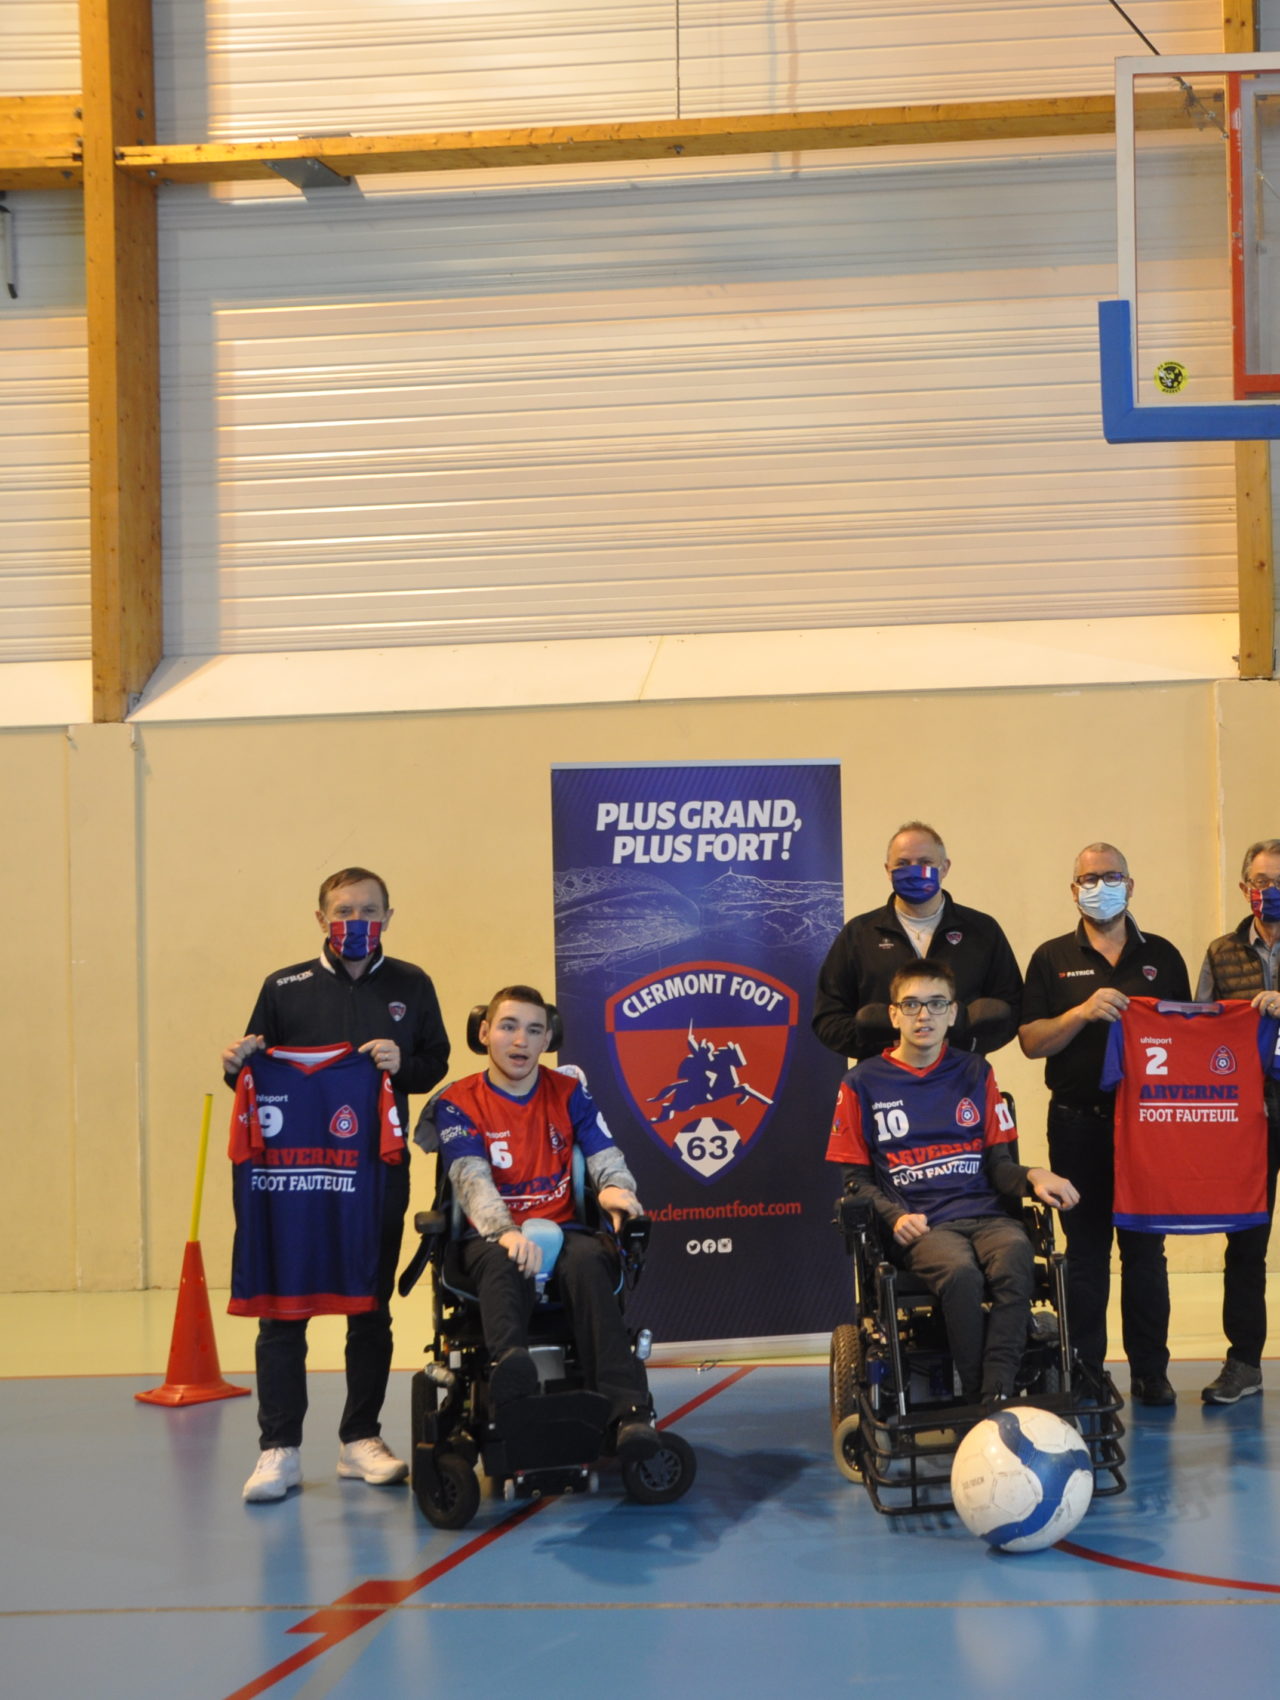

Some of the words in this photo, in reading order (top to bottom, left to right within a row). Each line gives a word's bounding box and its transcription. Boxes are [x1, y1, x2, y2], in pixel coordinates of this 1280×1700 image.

[596, 802, 676, 831] PLUS
[679, 799, 802, 832] GRAND,
[612, 834, 692, 864] PLUS
[696, 833, 779, 862] FORT
[622, 973, 726, 1018] CLERMONT
[729, 976, 784, 1012] FOOT
[1140, 1036, 1172, 1045] uhlsport
[1145, 1047, 1168, 1075] 2
[256, 1094, 288, 1103] hlsport
[1139, 1084, 1239, 1099] ARVERNE
[872, 1100, 903, 1111] uhlsport
[1139, 1109, 1174, 1122] FOOT
[1176, 1109, 1239, 1122] FAUTEUIL
[257, 1105, 283, 1137] 9
[874, 1110, 909, 1141] 10
[490, 1141, 513, 1169] 6
[686, 1135, 729, 1161] 63
[887, 1138, 982, 1168] ARVERNE
[252, 1175, 287, 1191] FOOT
[289, 1175, 356, 1192] FAUTEUIL
[893, 1170, 923, 1186] FOOT
[643, 1201, 802, 1222] w.clermontfoot.com
